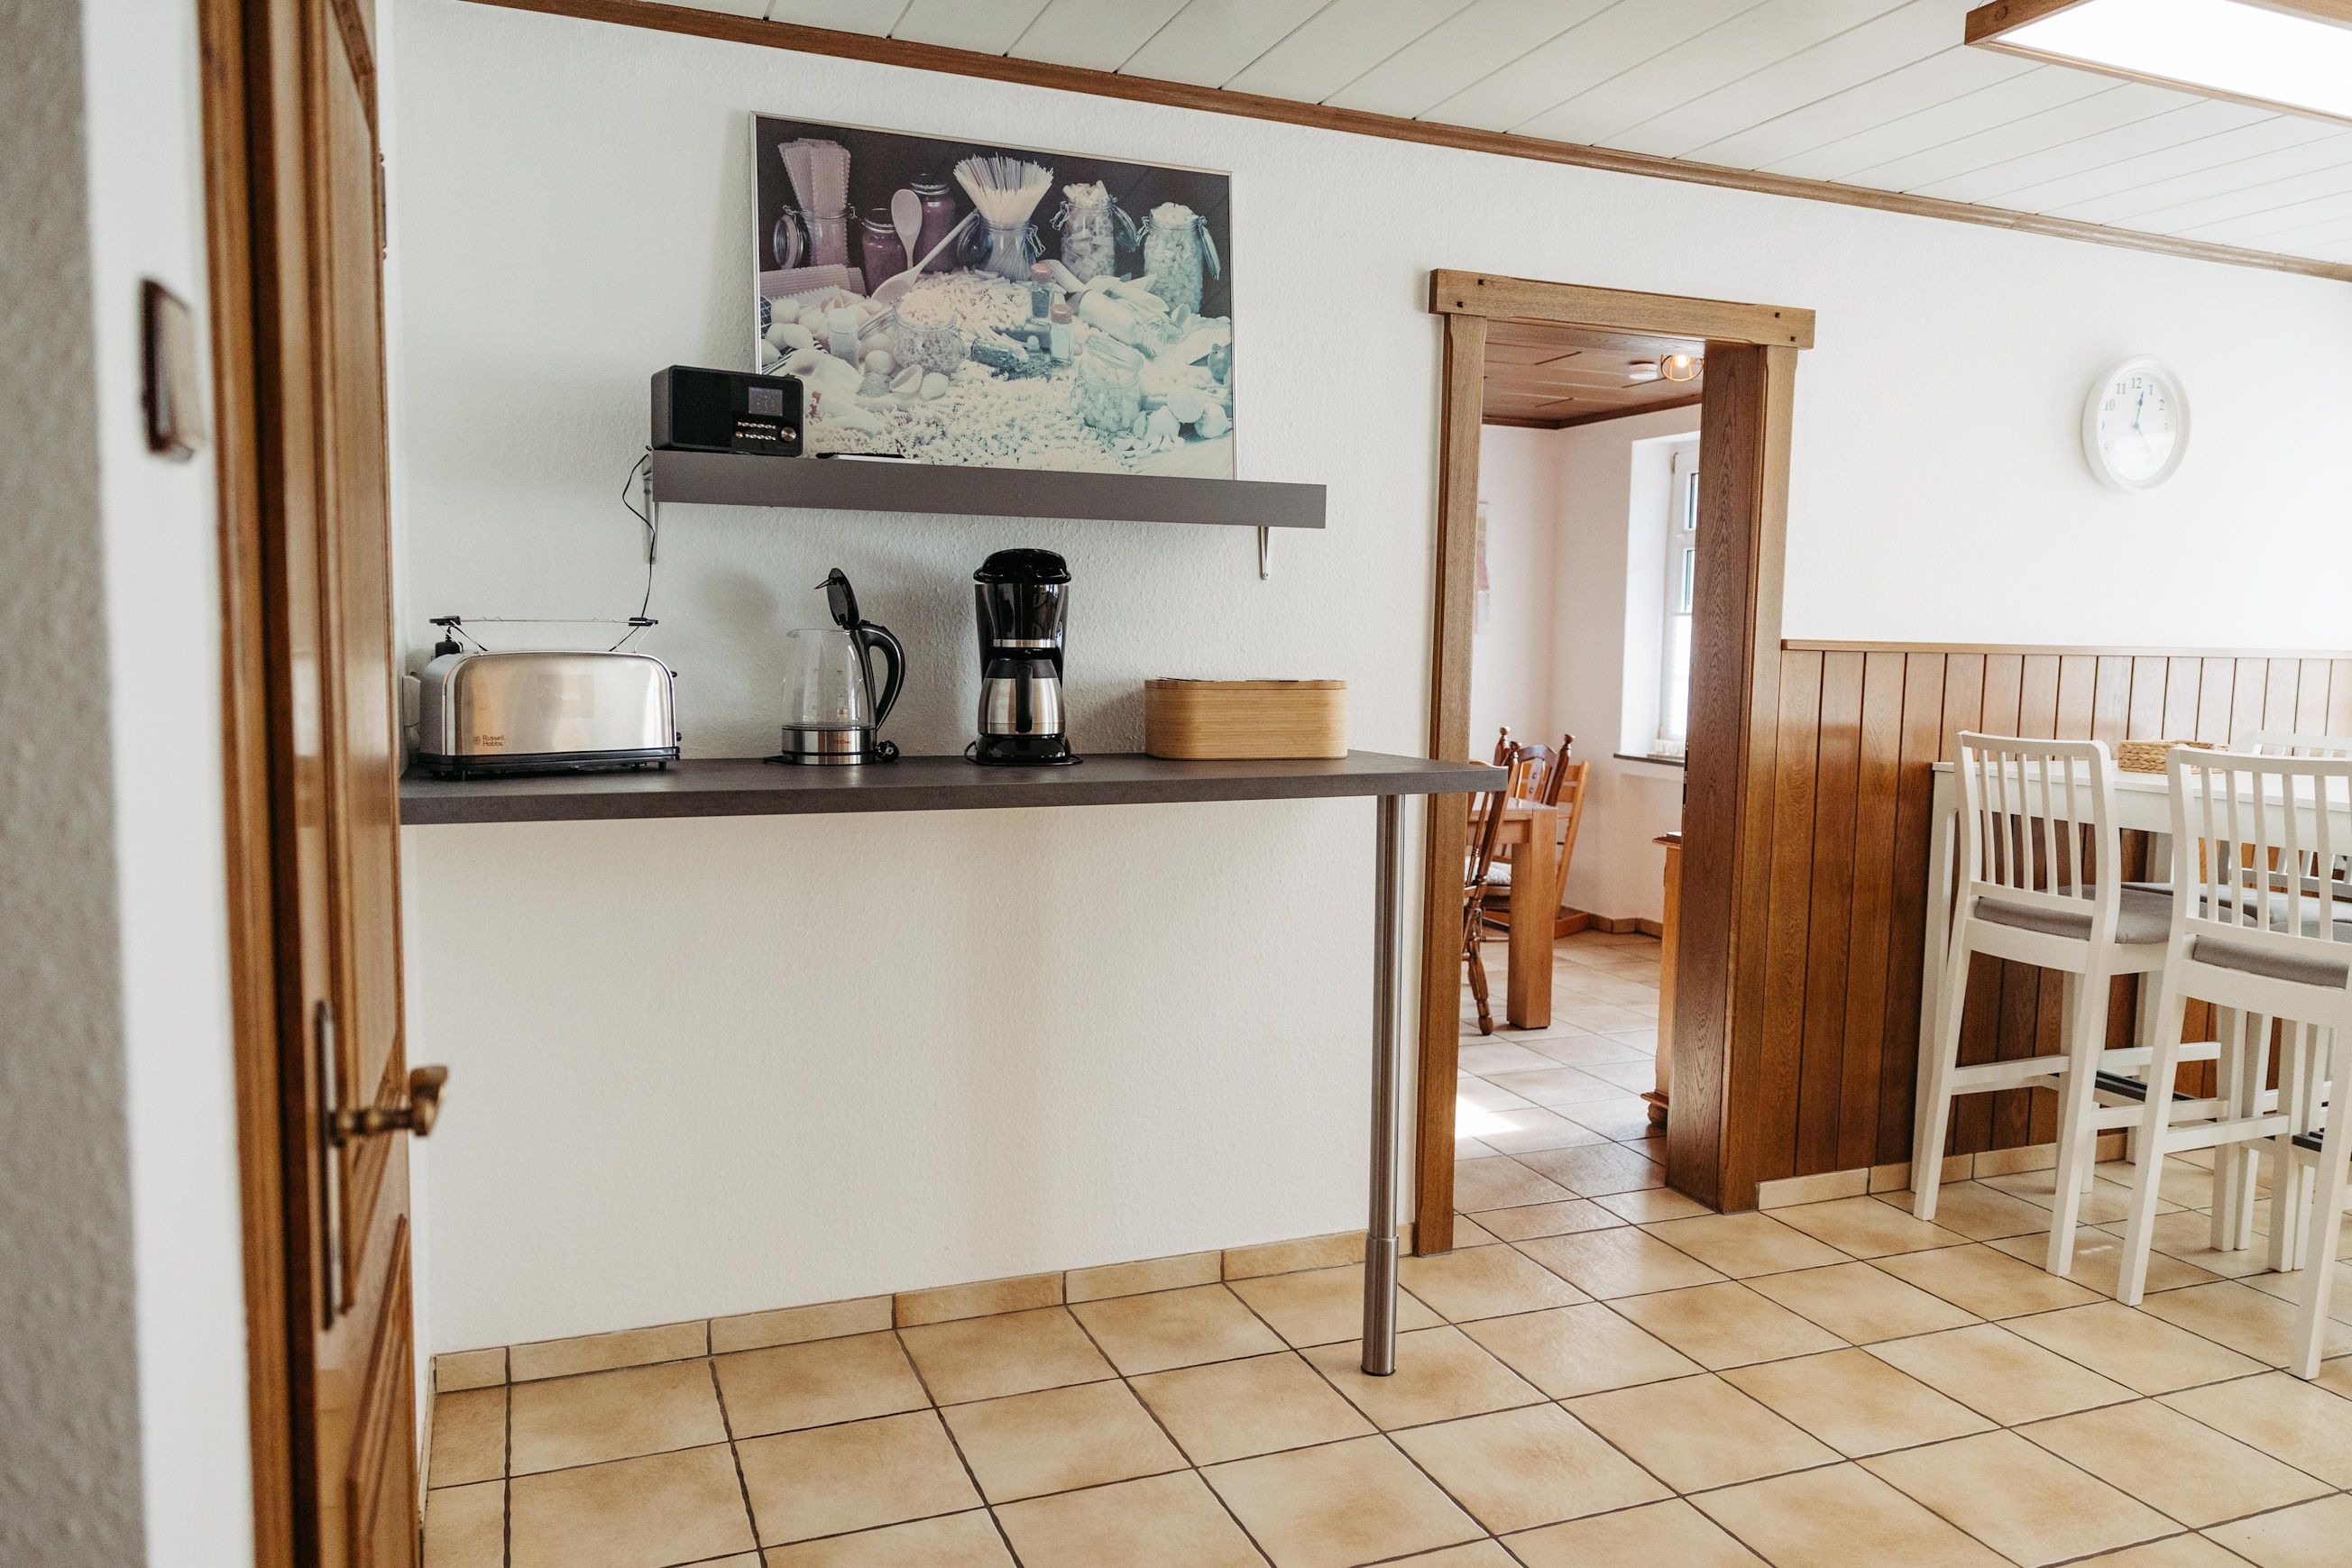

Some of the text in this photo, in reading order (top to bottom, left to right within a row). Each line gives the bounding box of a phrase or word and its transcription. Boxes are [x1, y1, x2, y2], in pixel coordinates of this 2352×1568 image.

[2117, 382, 2127, 394] 11
[2131, 377, 2142, 389] 12
[2149, 384, 2154, 396] 1
[2105, 399, 2116, 410] 10
[2158, 399, 2164, 410] 2
